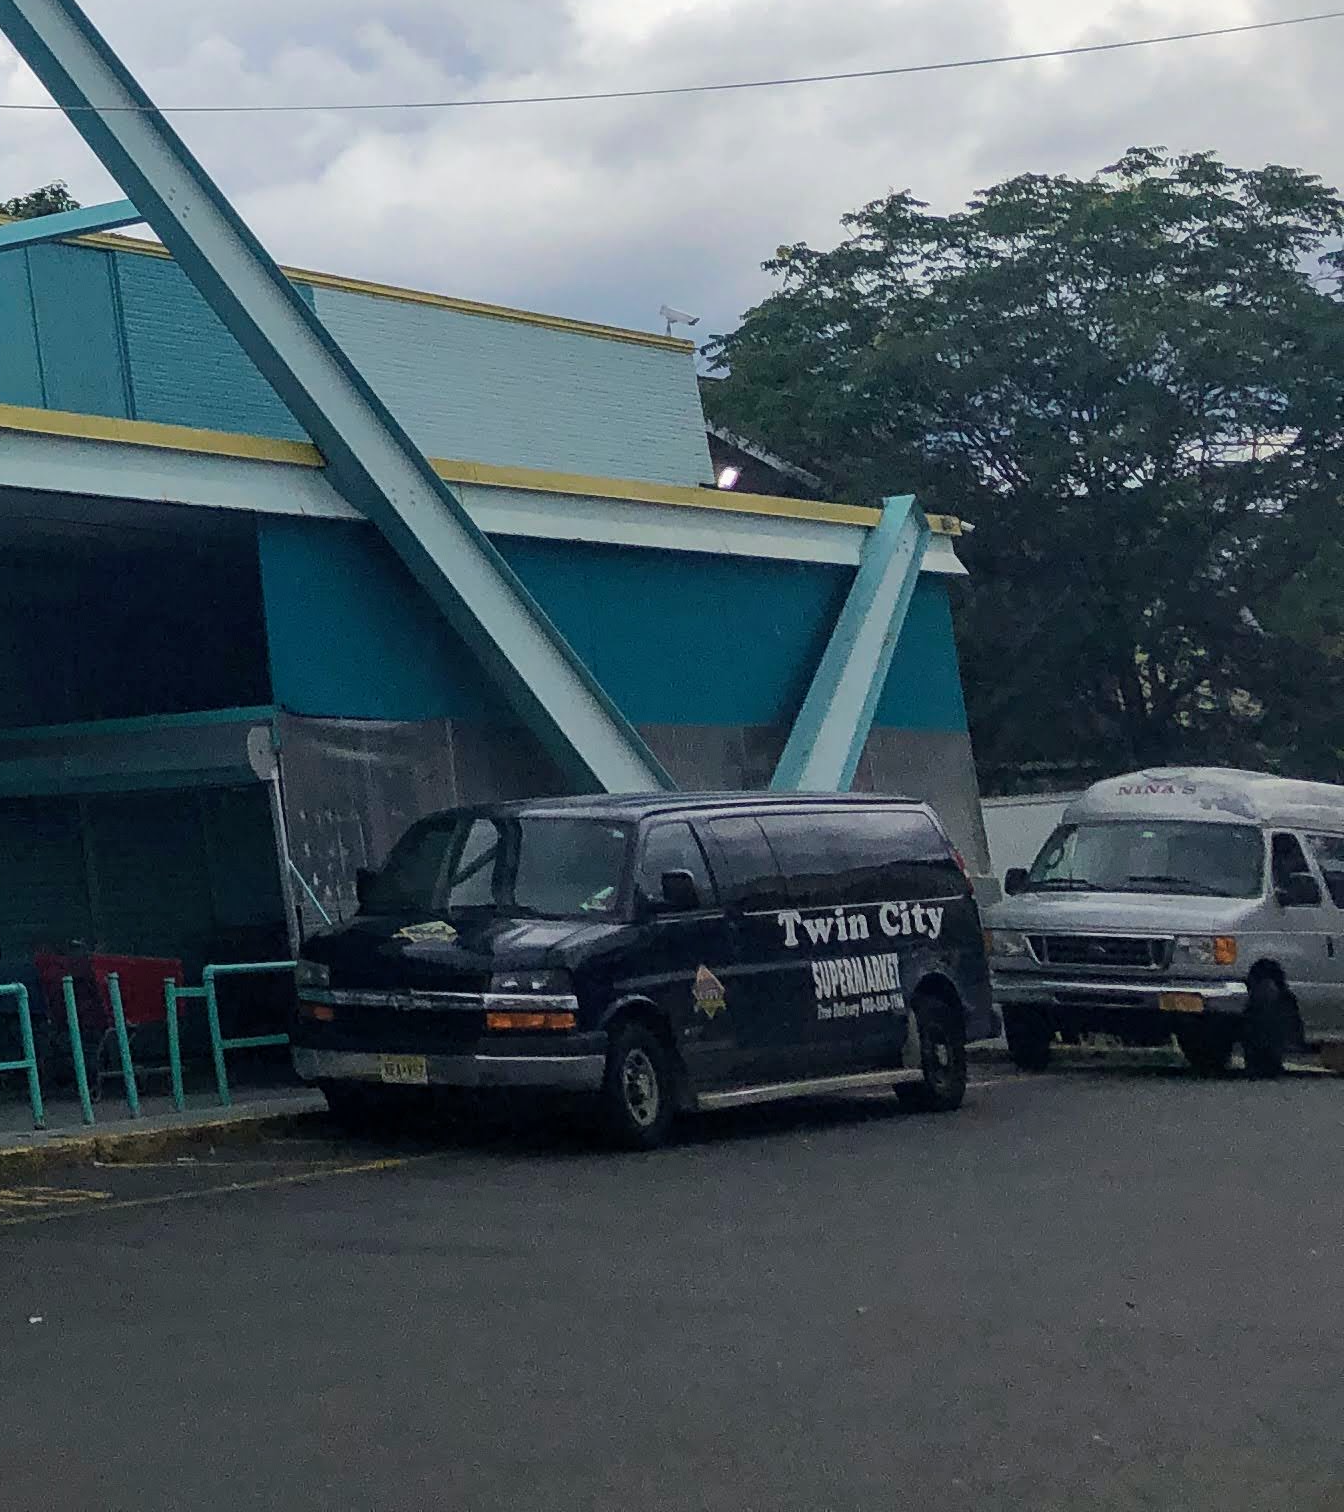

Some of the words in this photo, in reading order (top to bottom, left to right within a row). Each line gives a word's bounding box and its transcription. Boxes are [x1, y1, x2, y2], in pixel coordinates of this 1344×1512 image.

[777, 908, 870, 947] Twin
[878, 901, 944, 939] City
[812, 952, 902, 1001] SUPERMARKET
